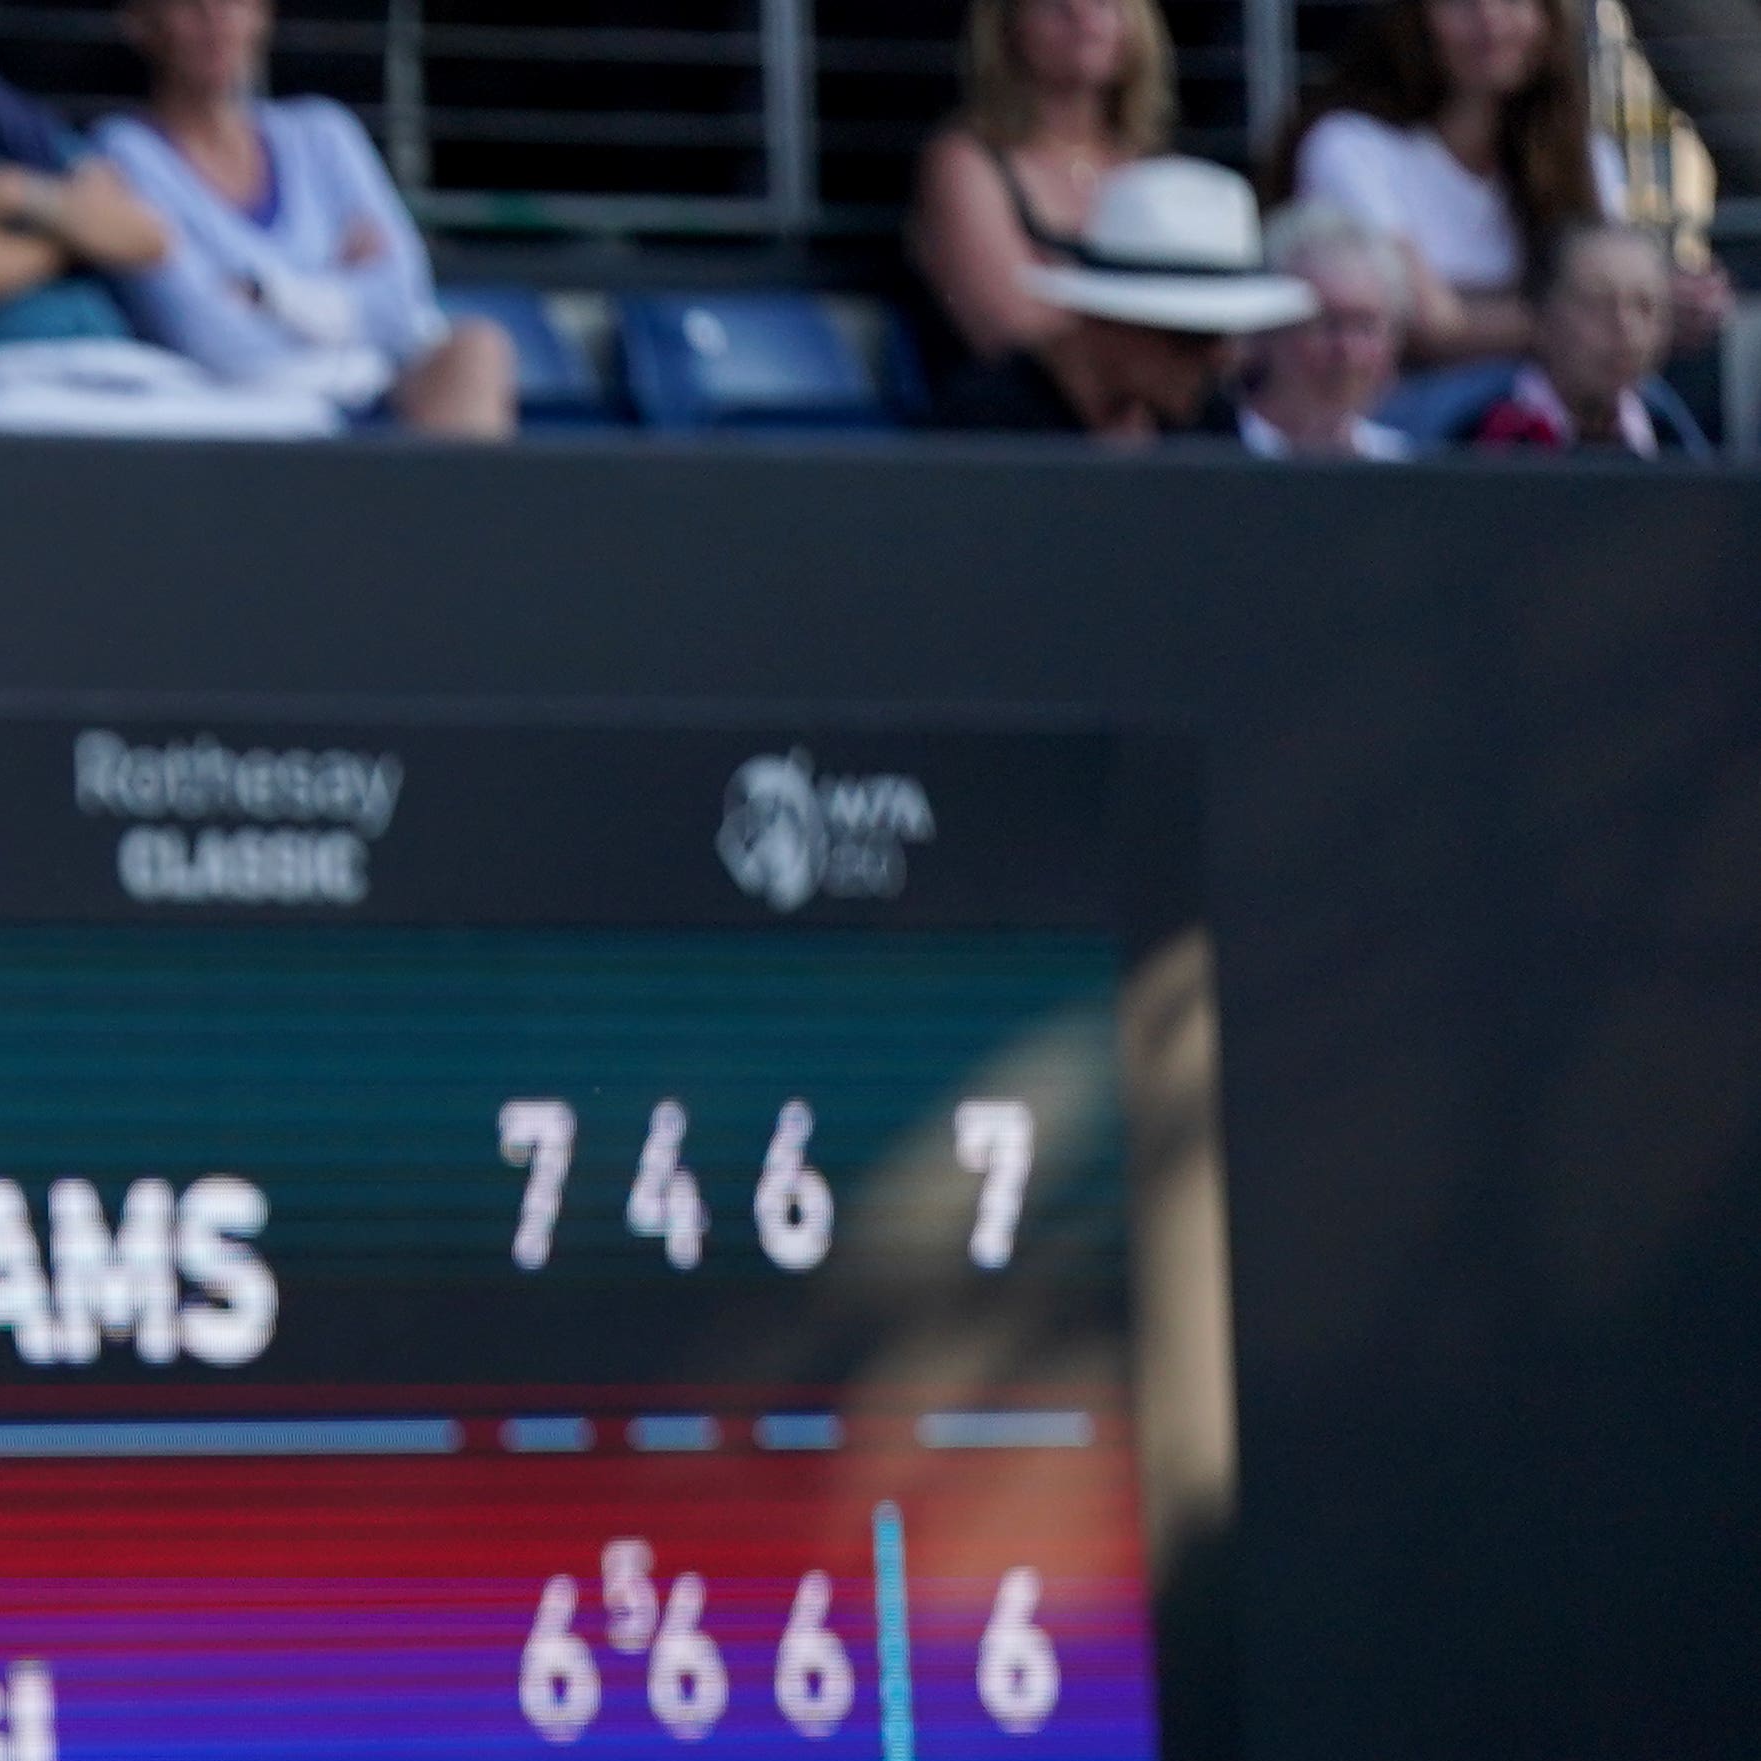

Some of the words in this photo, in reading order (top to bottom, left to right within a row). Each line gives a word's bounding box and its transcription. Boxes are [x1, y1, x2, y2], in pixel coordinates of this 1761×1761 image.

[75, 729, 405, 841] Rothesay
[118, 823, 369, 904] CLASSIC
[498, 1100, 575, 1269] 7
[627, 1100, 707, 1269] 4
[754, 1100, 834, 1269] 6
[955, 1100, 1033, 1268] 7
[518, 1573, 601, 1742] 6
[647, 1572, 727, 1740] 6
[774, 1569, 854, 1738] 6
[976, 1567, 1060, 1735] 6
